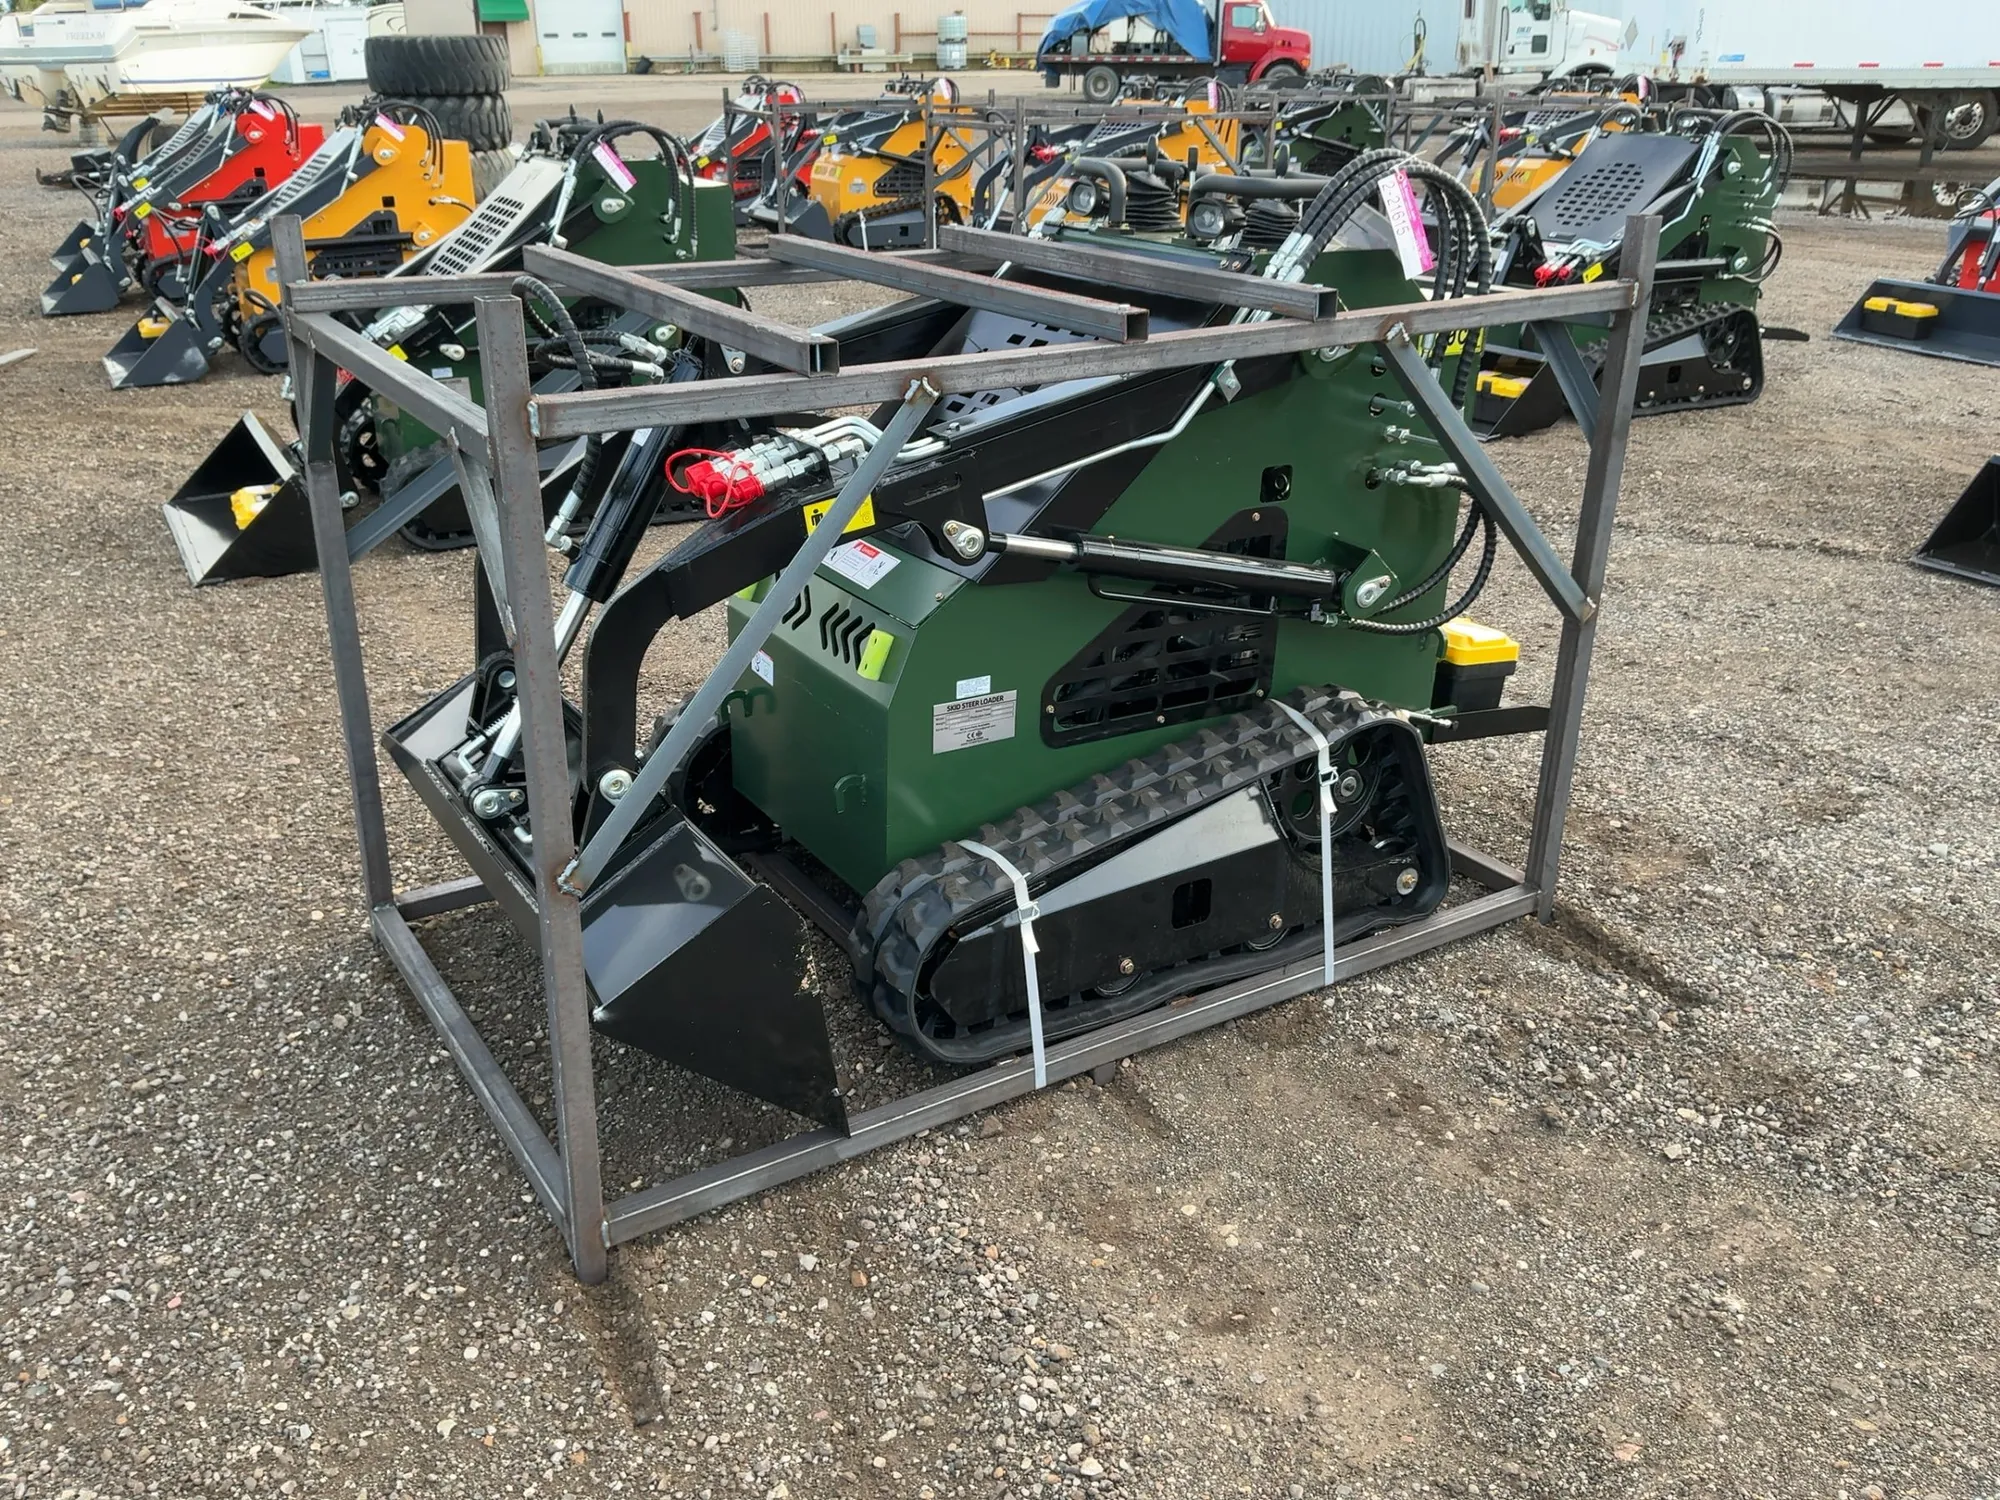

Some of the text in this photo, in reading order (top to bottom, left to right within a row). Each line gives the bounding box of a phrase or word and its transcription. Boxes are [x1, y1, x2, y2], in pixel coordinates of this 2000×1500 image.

[65, 31, 105, 40] FREEDOM
[1382, 183, 1410, 236] 2-21615
[946, 695, 1004, 712] SKID STEER LOADER
